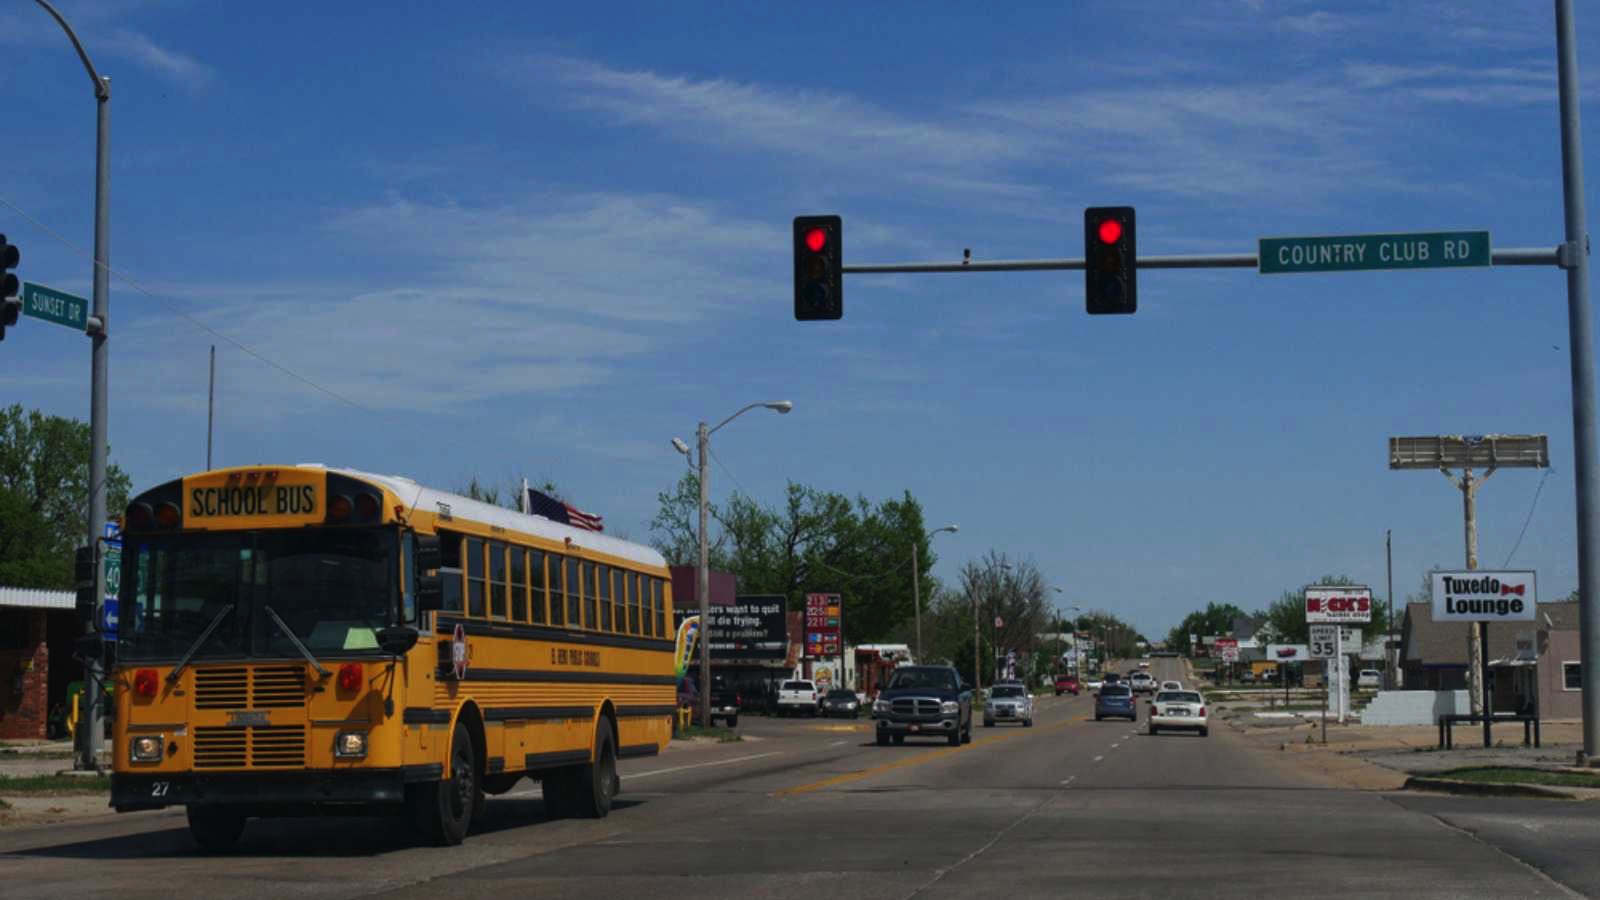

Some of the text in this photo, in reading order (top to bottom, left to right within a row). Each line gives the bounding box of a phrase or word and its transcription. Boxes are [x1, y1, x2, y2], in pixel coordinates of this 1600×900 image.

[1278, 240, 1470, 265] COUNTRY CLUB RD
[31, 292, 81, 321] SUNSET DR
[191, 485, 313, 517] SCHOOL BUS
[106, 567, 121, 588] 40
[1442, 576, 1500, 594] Tuxedo
[750, 604, 760, 613] to
[761, 604, 780, 615] quit
[1445, 597, 1524, 616] Lounge
[1312, 642, 1334, 656] 35
[151, 781, 169, 797] 27
